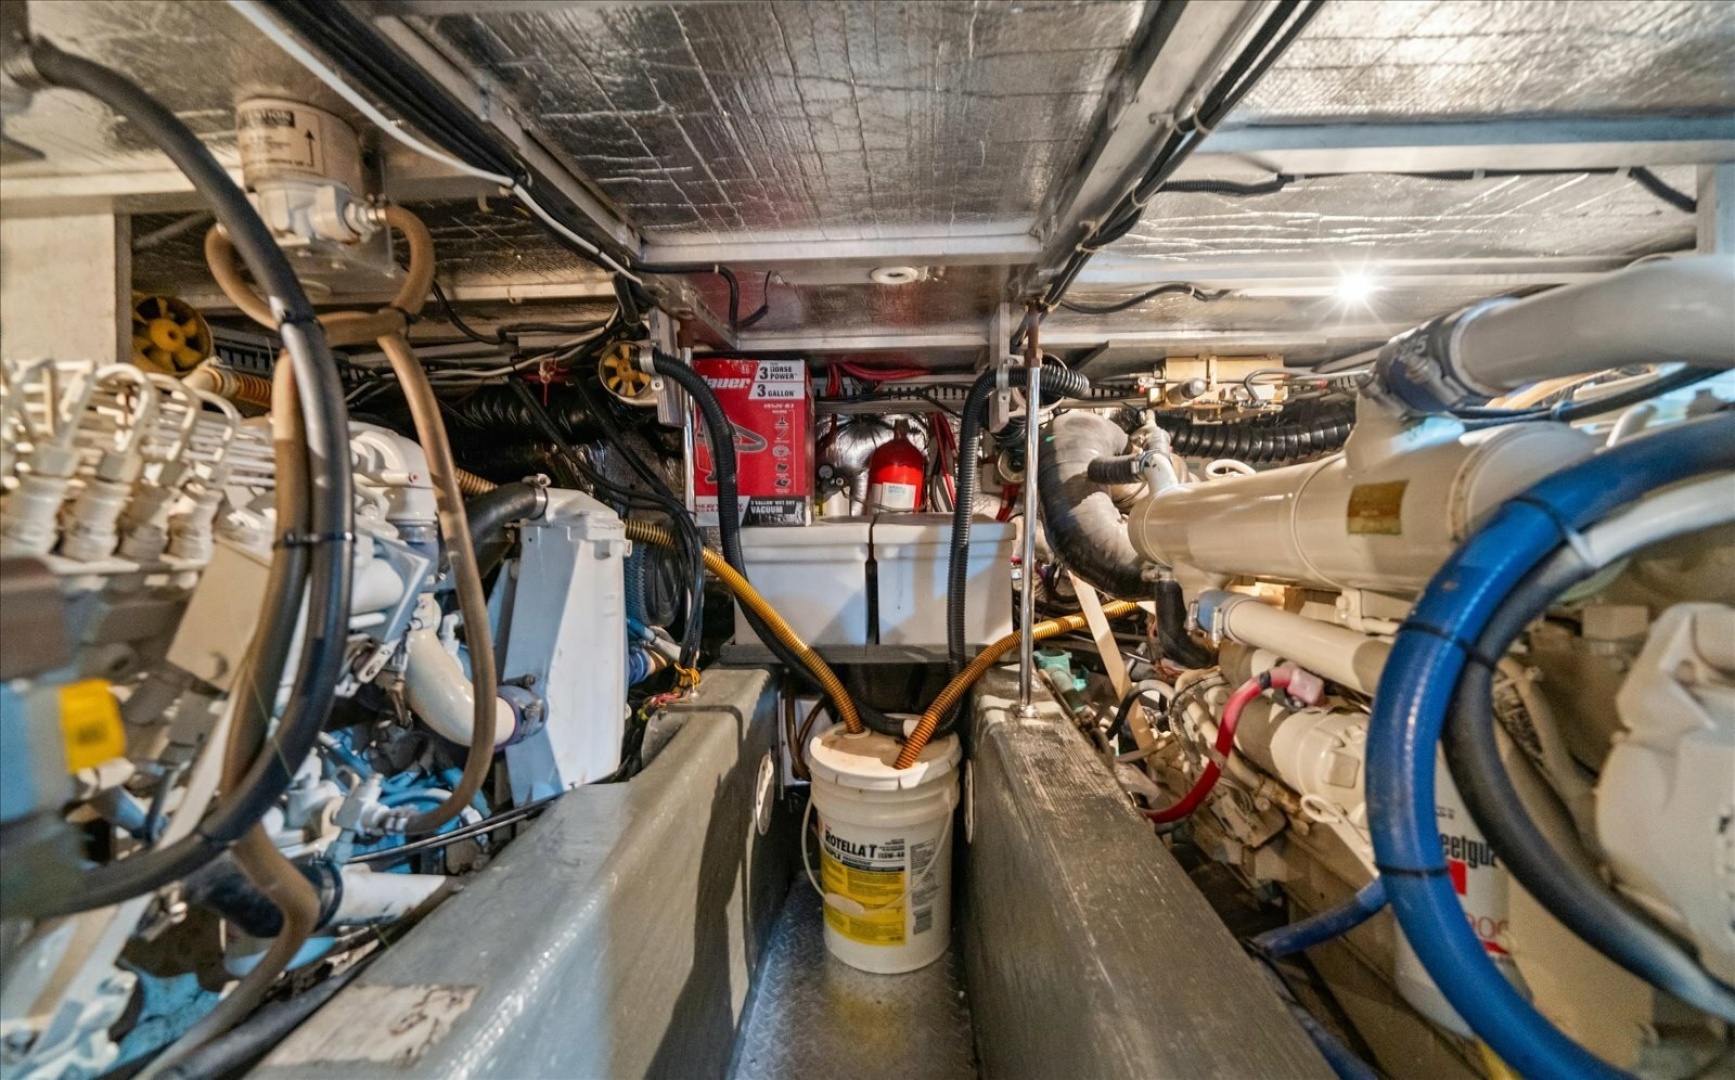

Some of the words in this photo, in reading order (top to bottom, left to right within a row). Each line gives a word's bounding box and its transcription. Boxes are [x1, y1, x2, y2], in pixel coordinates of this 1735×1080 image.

[759, 366, 768, 380] 3
[701, 375, 751, 389] auer
[757, 384, 766, 397] 3
[750, 506, 783, 514] VACUUM
[825, 829, 866, 858] ROTELLA
[870, 845, 877, 858] T
